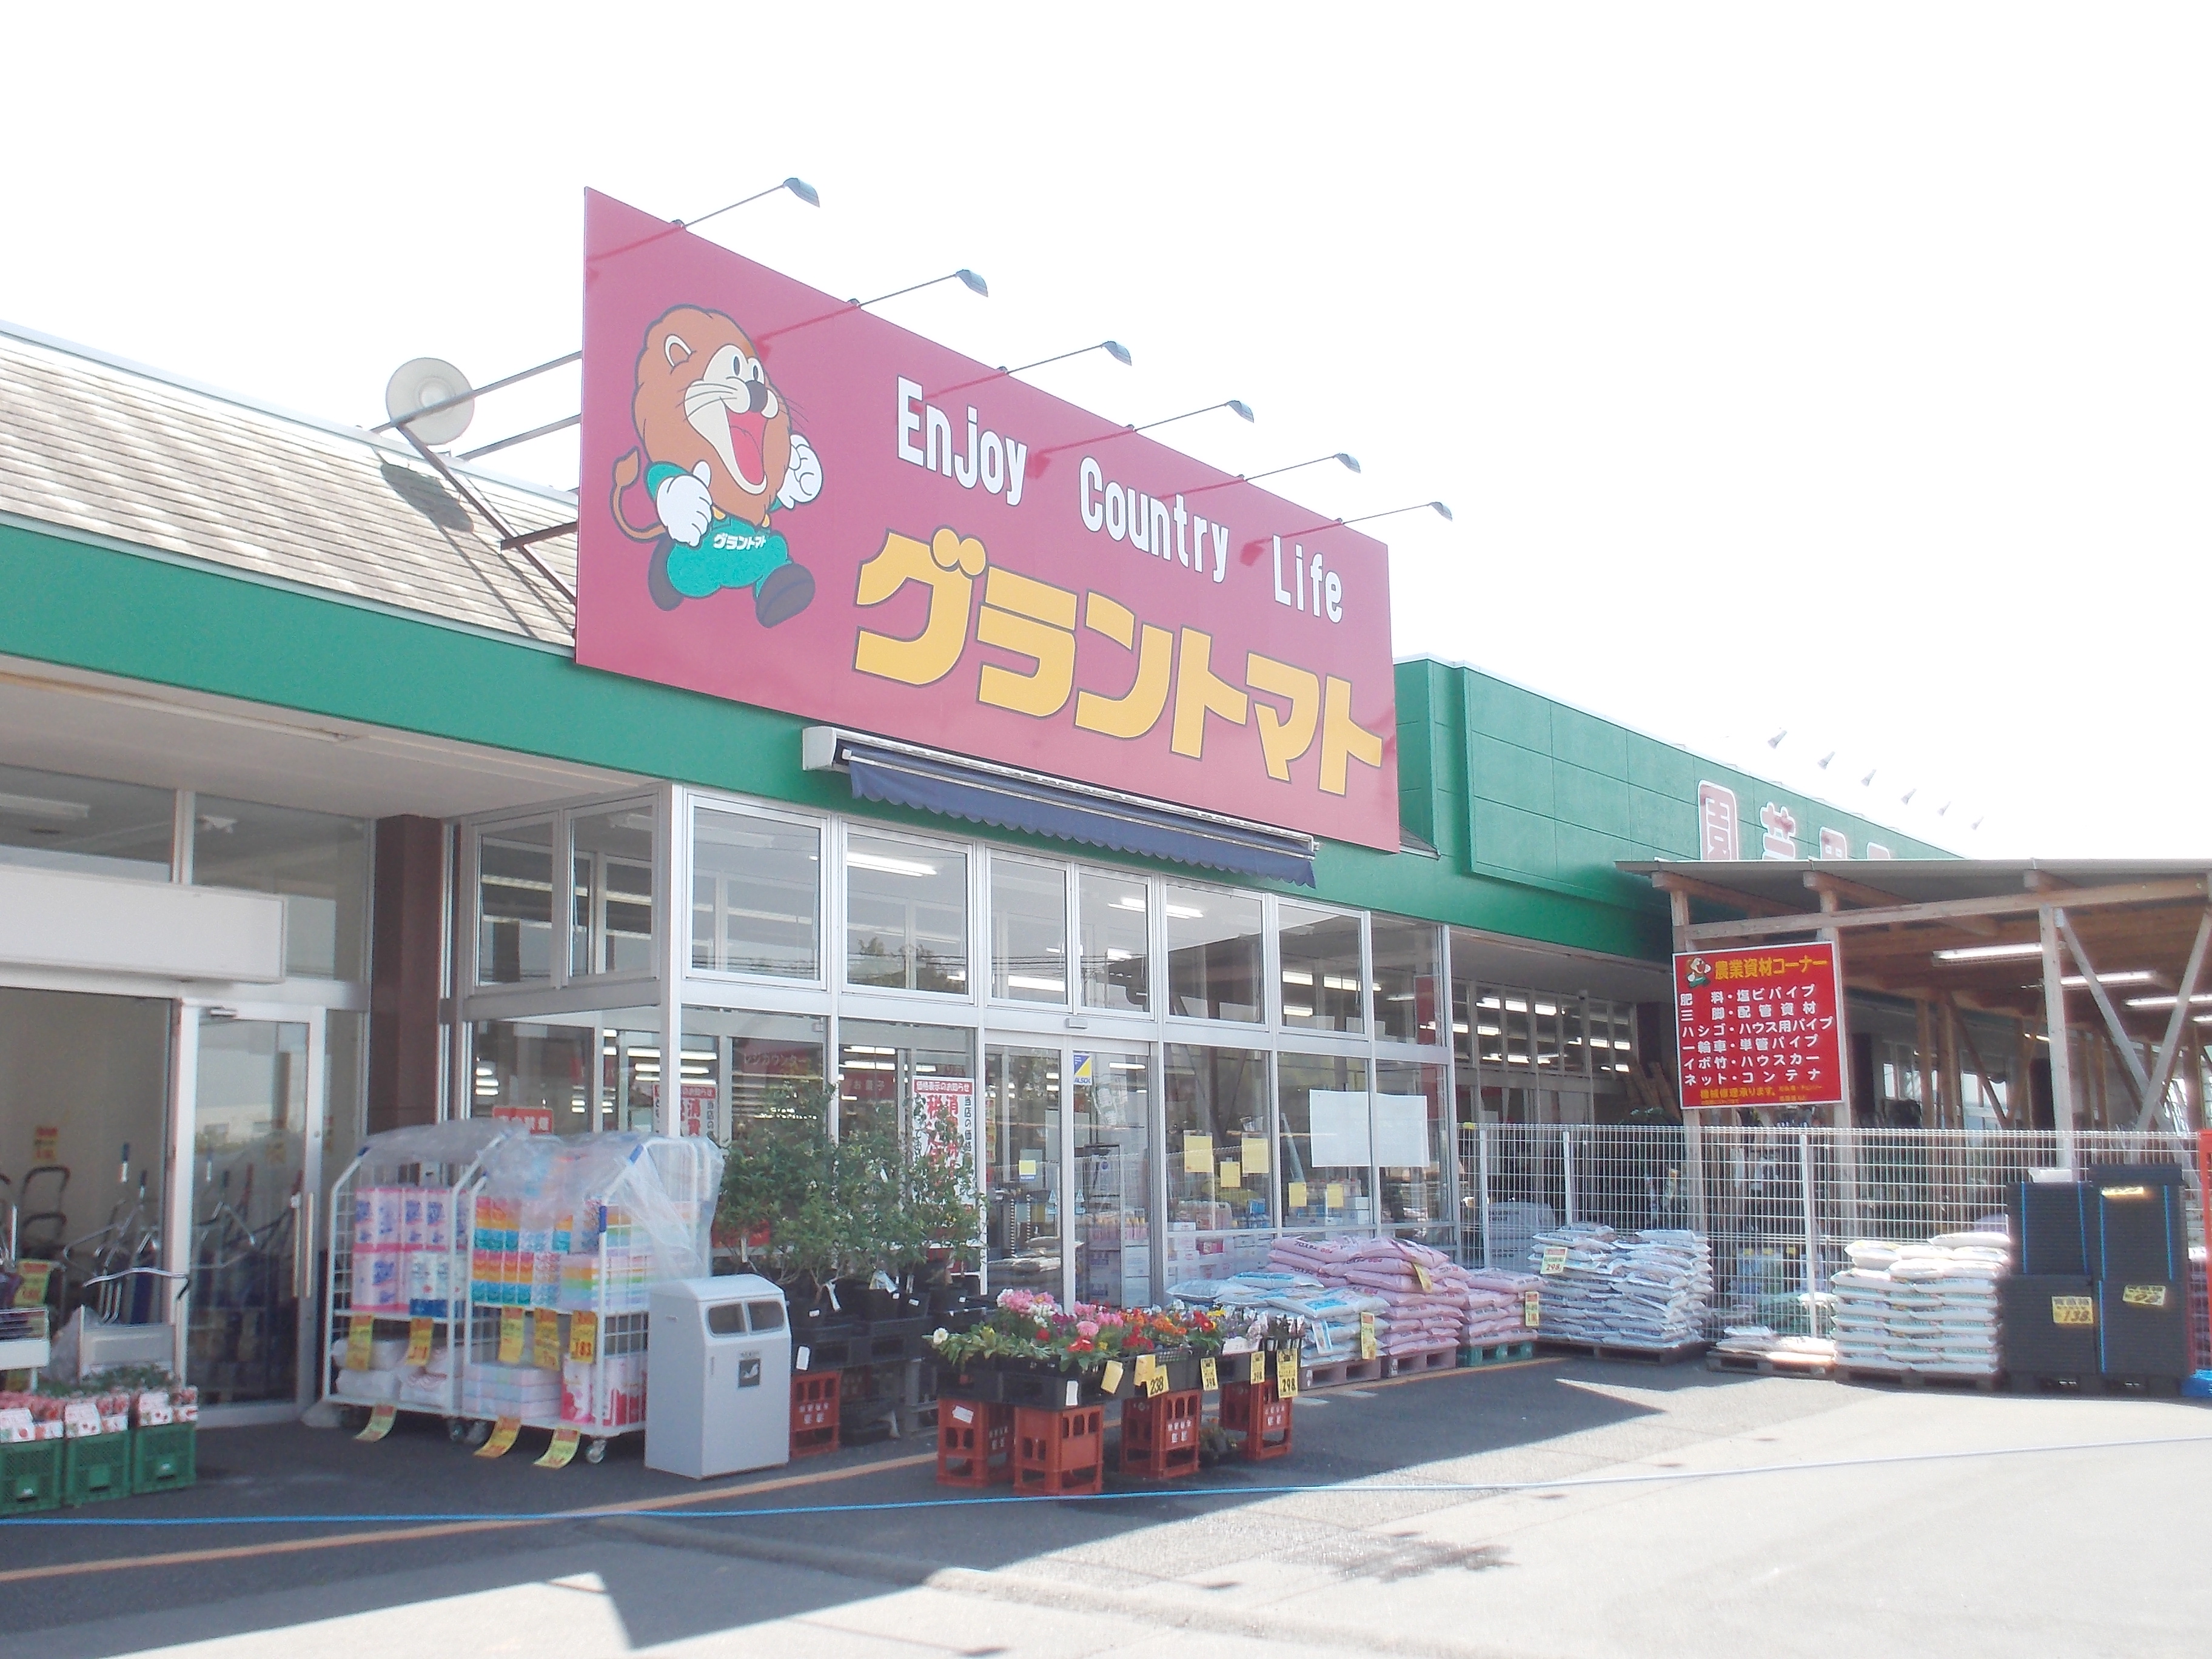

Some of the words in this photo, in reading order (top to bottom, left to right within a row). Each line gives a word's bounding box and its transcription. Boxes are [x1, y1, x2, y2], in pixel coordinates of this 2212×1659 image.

[897, 375, 1028, 506] Enjoy
[1079, 457, 1229, 584] Country
[1273, 535, 1342, 623] Life
[854, 525, 1383, 797] グラントマト
[1715, 955, 1828, 980] 農業資材コーナー
[1150, 1376, 1164, 1395] 238
[1282, 1377, 1296, 1393] 298
